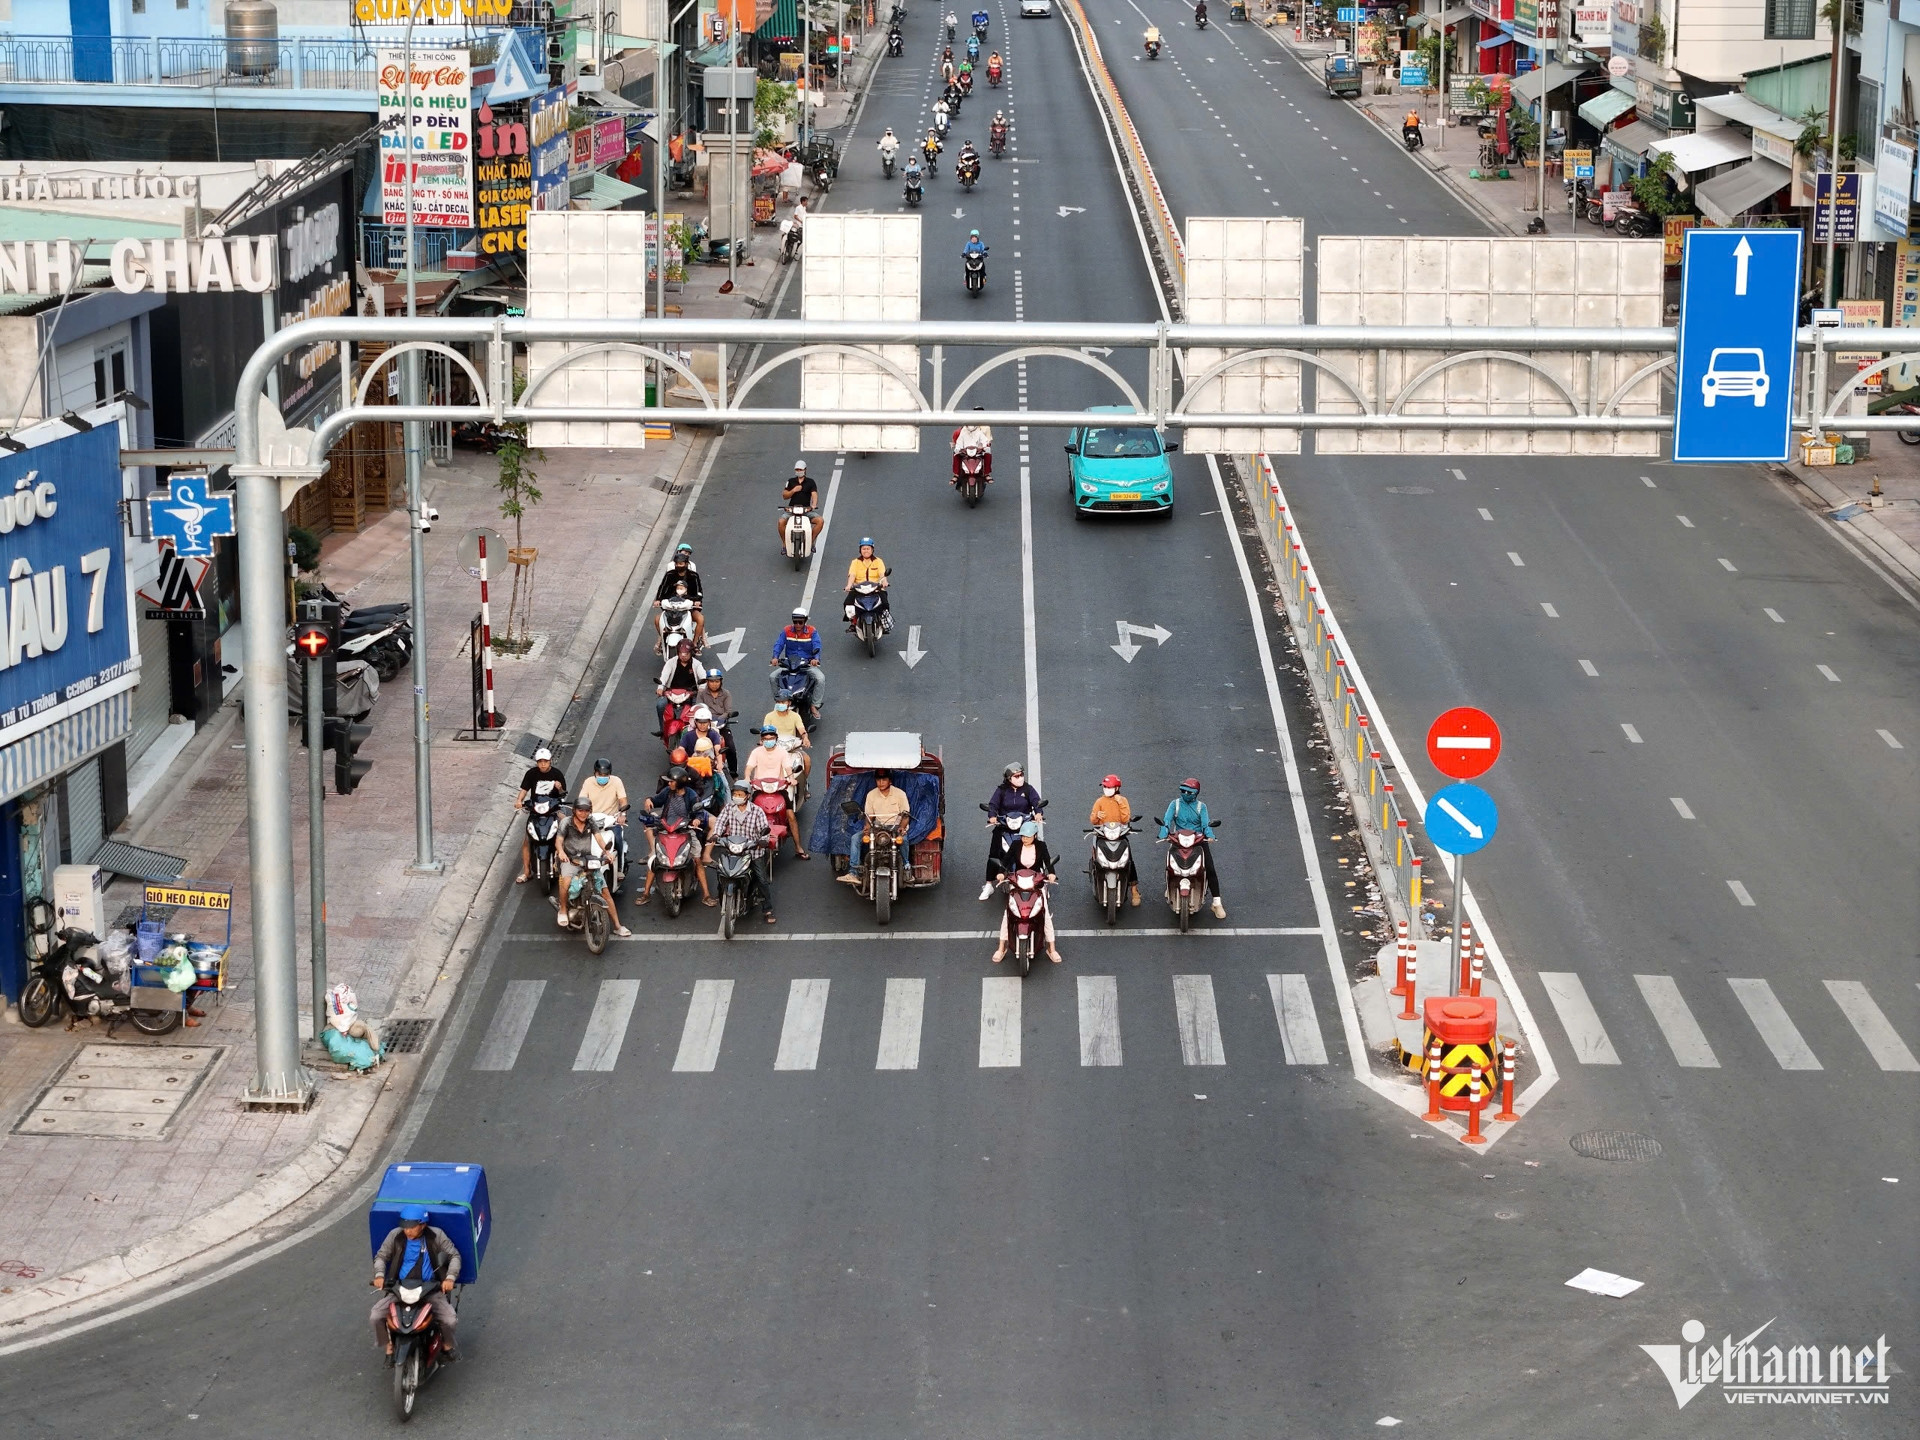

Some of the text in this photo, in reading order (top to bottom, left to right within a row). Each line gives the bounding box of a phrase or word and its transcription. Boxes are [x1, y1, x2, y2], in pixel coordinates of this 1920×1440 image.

[435, 53, 456, 61] CÔNG
[429, 94, 467, 112] HIỆU
[427, 112, 459, 128] ĐÈN
[428, 131, 468, 150] LED
[422, 176, 440, 184] TEM
[443, 187, 452, 199] SỐ
[501, 183, 531, 202] CÔNG
[445, 204, 470, 214] DECAL
[110, 223, 273, 294] CHÂU
[81, 547, 110, 634] 7
[166, 892, 186, 905] HEO
